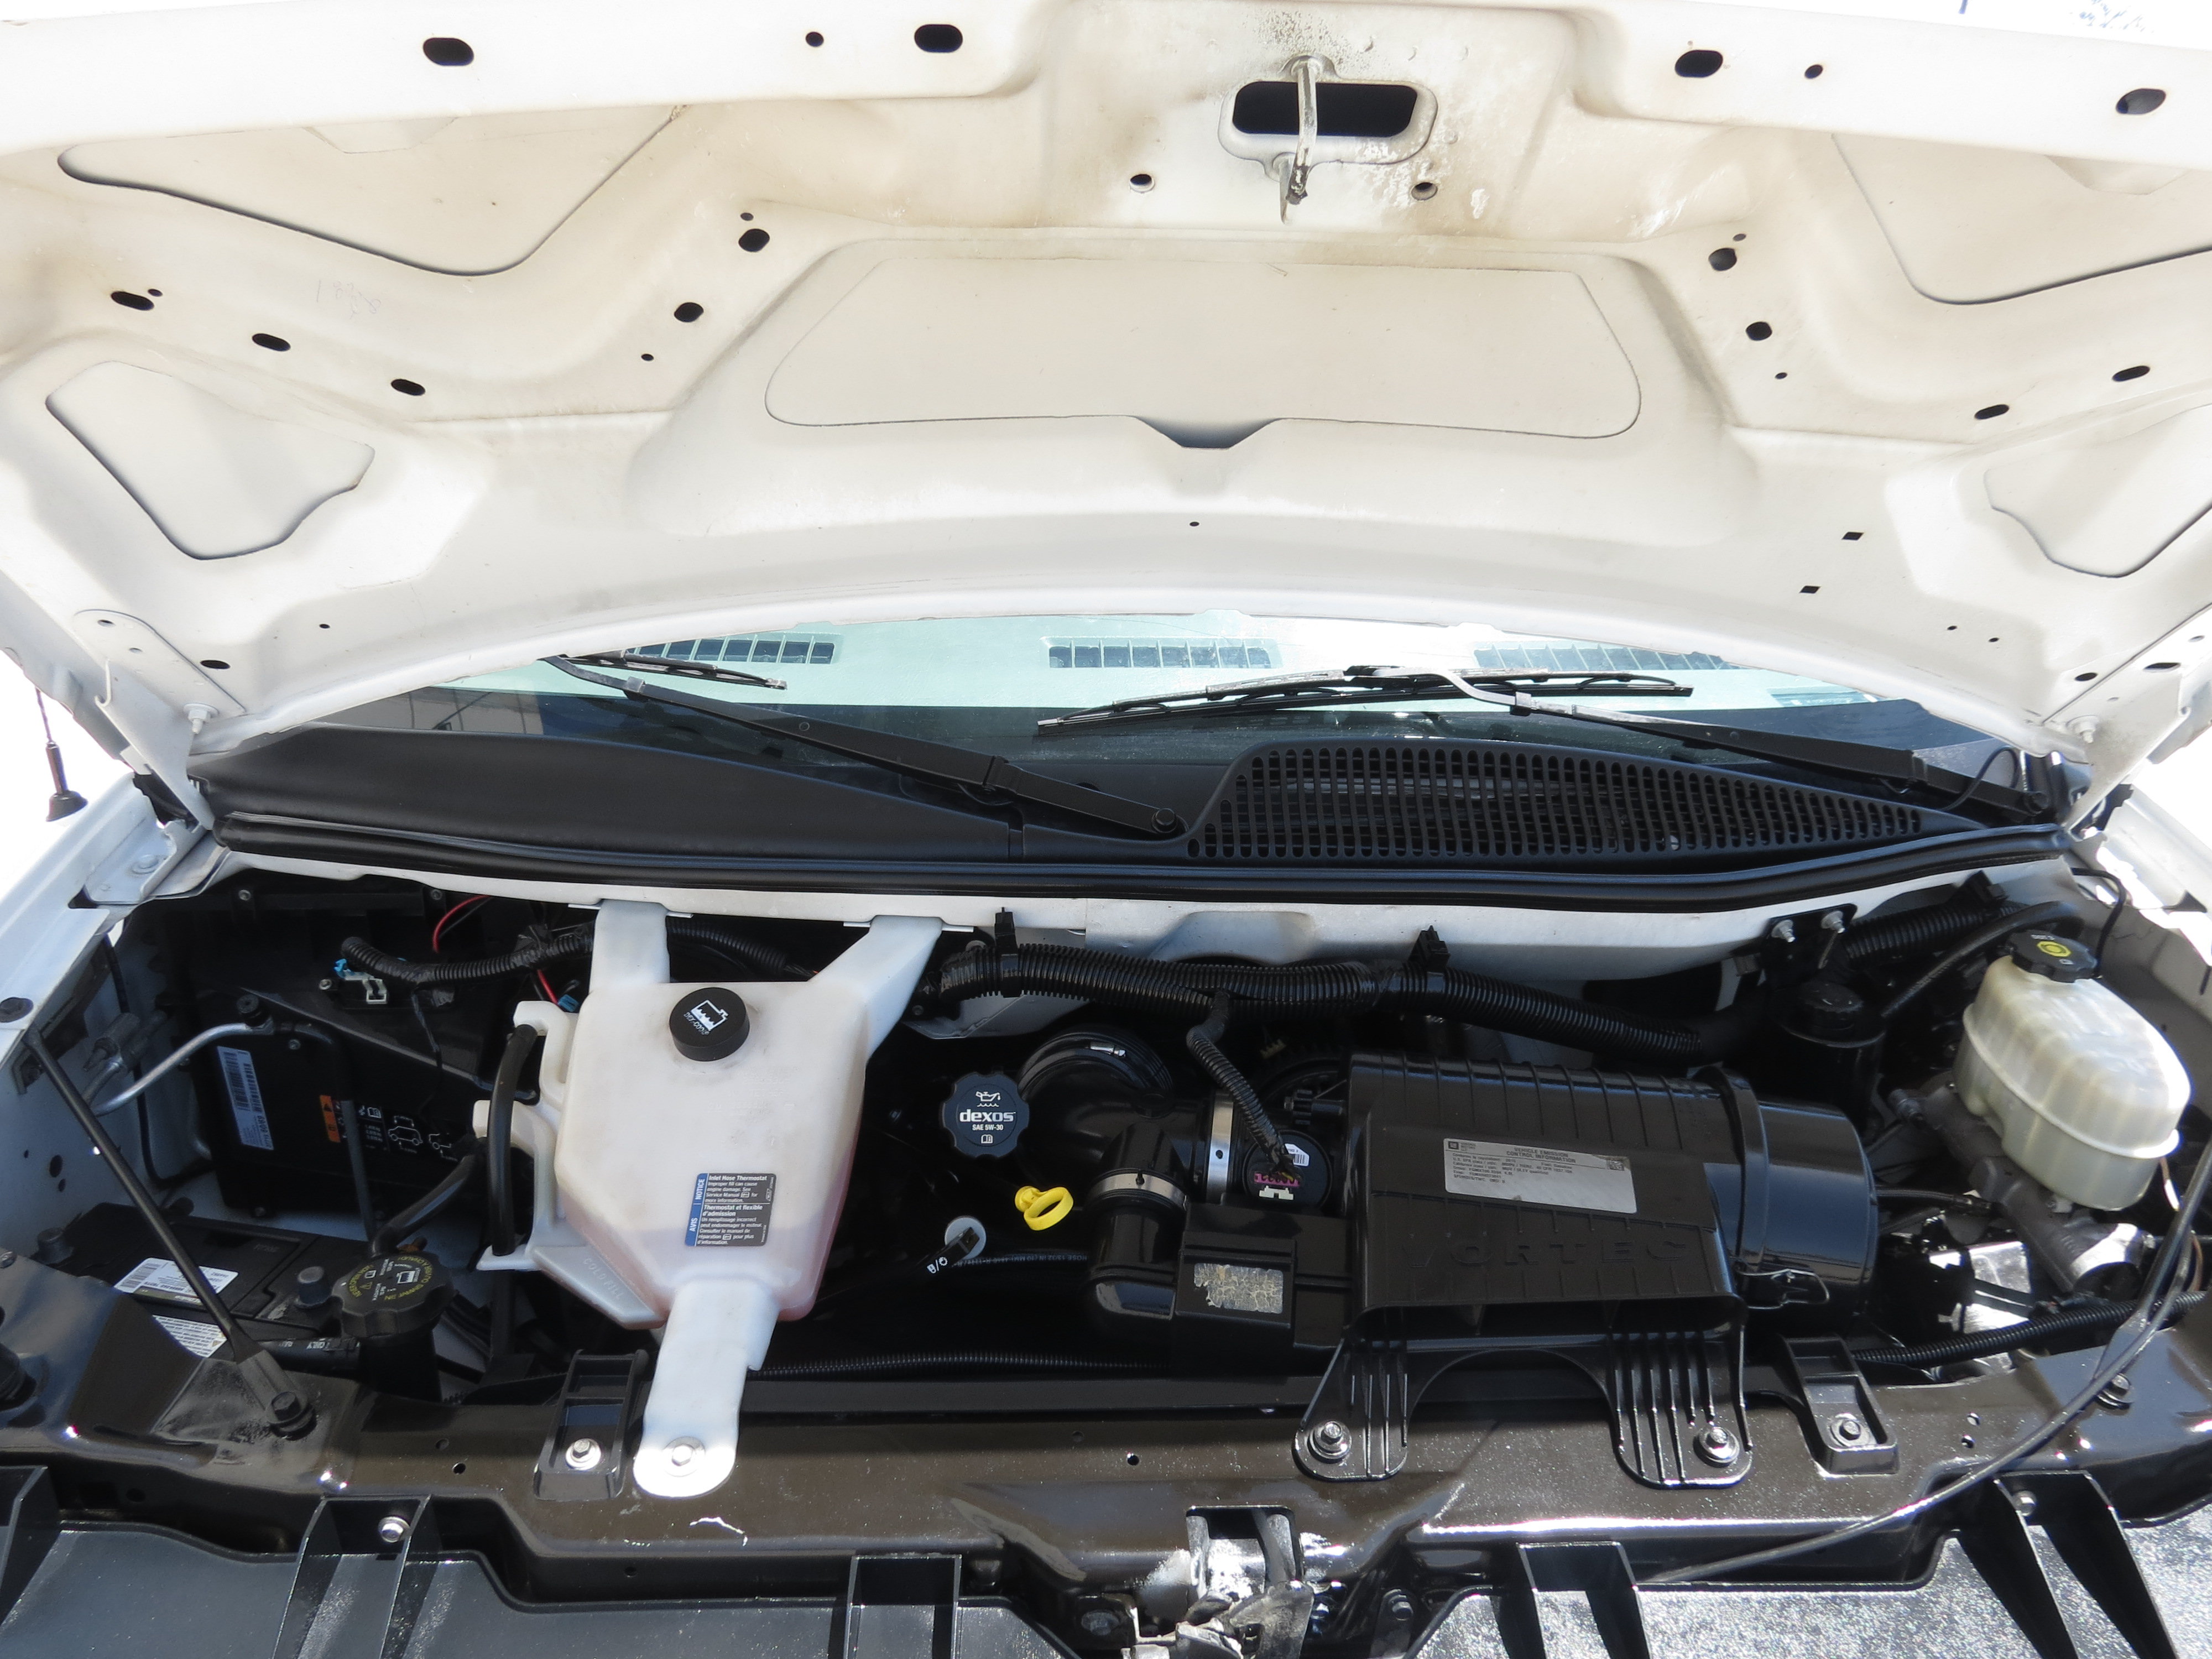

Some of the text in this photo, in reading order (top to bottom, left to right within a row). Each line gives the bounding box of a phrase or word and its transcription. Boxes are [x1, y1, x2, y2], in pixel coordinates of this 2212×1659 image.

[959, 1109, 1014, 1122] dexos
[695, 1178, 705, 1200] NOTICE
[689, 1217, 698, 1232] AVIS
[1401, 1239, 1687, 1269] VORTEC
